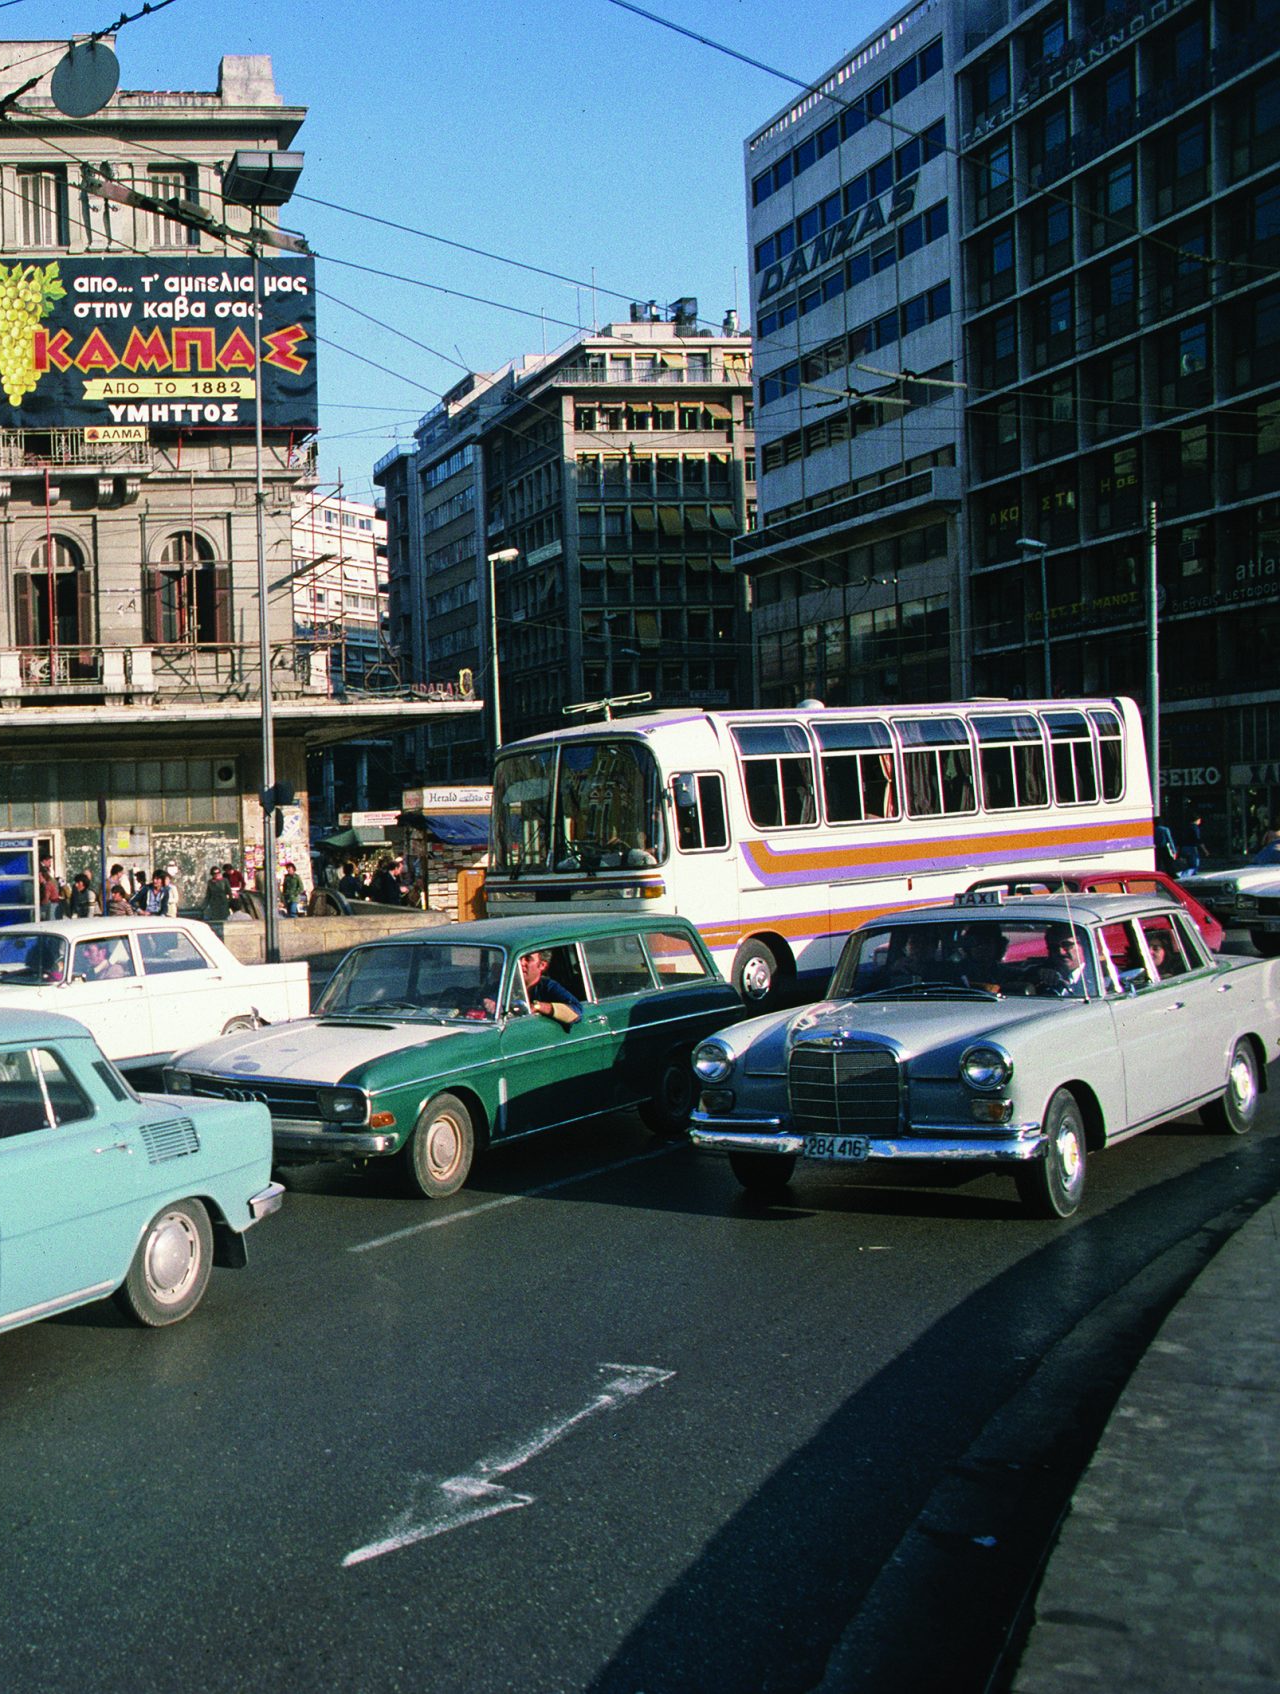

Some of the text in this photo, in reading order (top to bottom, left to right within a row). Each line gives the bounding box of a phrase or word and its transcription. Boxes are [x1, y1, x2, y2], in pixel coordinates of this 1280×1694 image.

[758, 171, 919, 304] DANZAS
[164, 272, 255, 296] αμπελια
[264, 276, 308, 296] μας
[73, 296, 263, 321] στην καβα σας
[31, 322, 309, 376] ΚΑΜΠΑΣ
[103, 381, 242, 394] ΑΠΟ ΤΟ 1882
[108, 403, 239, 422] ΥΜΗΤΤΟΣ
[102, 429, 142, 440] ΑΛΜΑ
[1160, 766, 1219, 786] SEIKO
[429, 791, 457, 803] Herald
[954, 892, 995, 905] TAXI
[837, 1140, 862, 1157] 416
